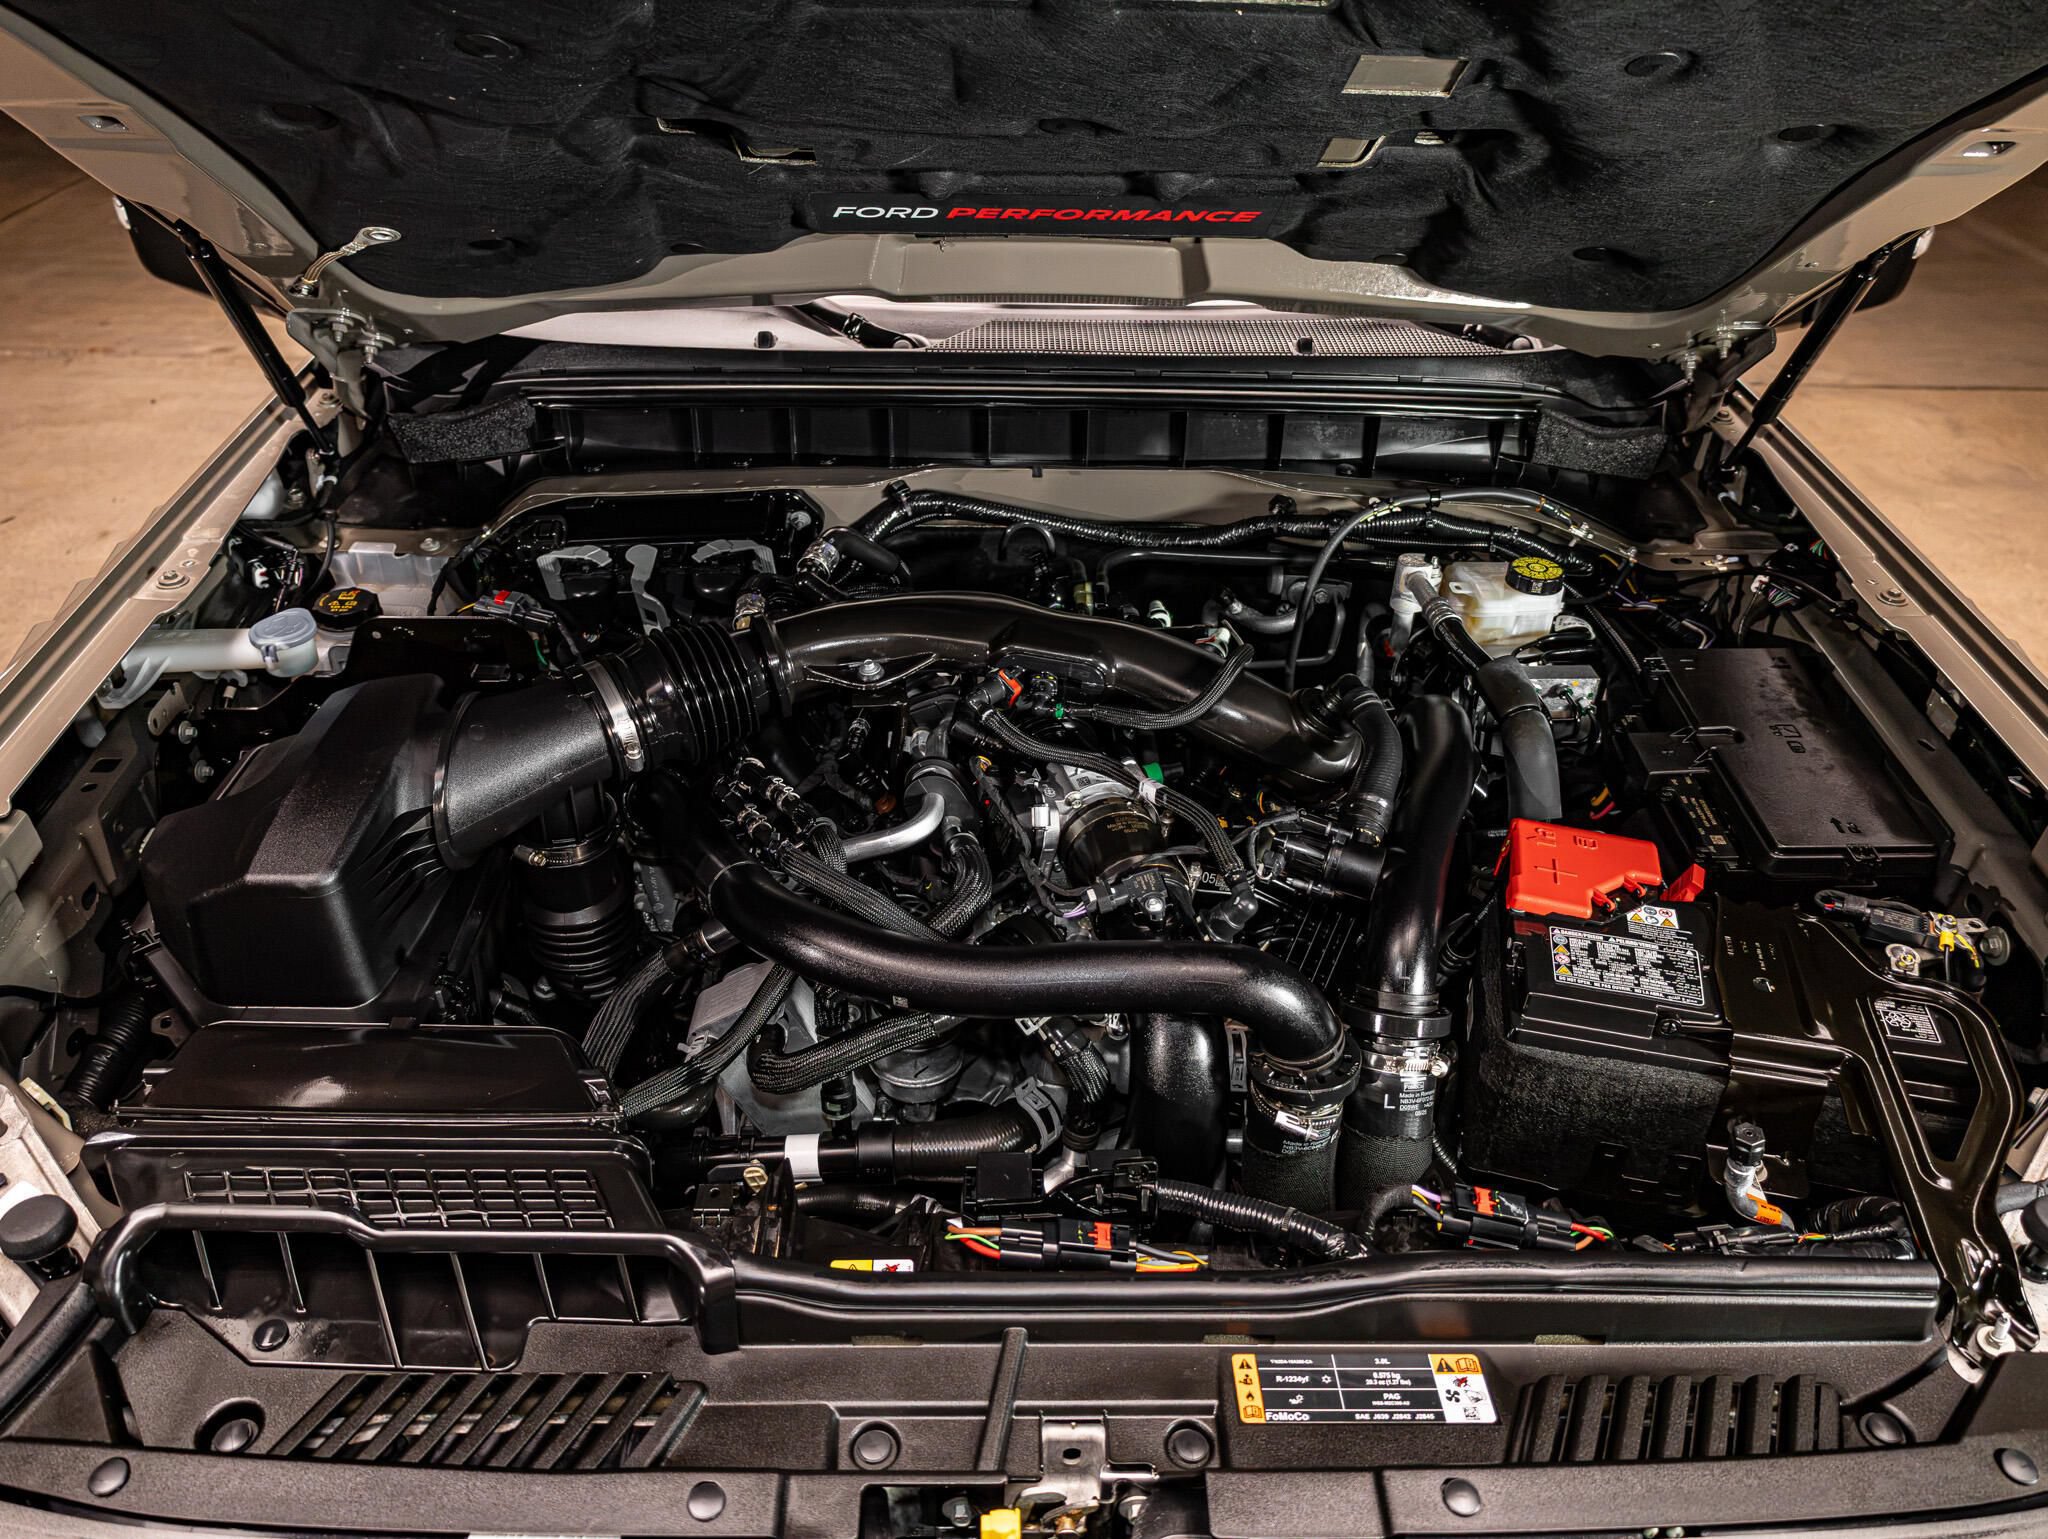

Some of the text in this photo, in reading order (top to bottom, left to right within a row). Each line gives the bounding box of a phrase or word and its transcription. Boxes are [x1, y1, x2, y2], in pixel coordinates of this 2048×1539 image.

[832, 206, 1261, 223] FORD PERFORMANCE
[1384, 1093, 1396, 1109] L
[1275, 1375, 1310, 1384] R-1234yf
[1391, 1371, 1401, 1381] kg
[1383, 1392, 1401, 1401] PAG
[1266, 1411, 1311, 1422] FoMoCo
